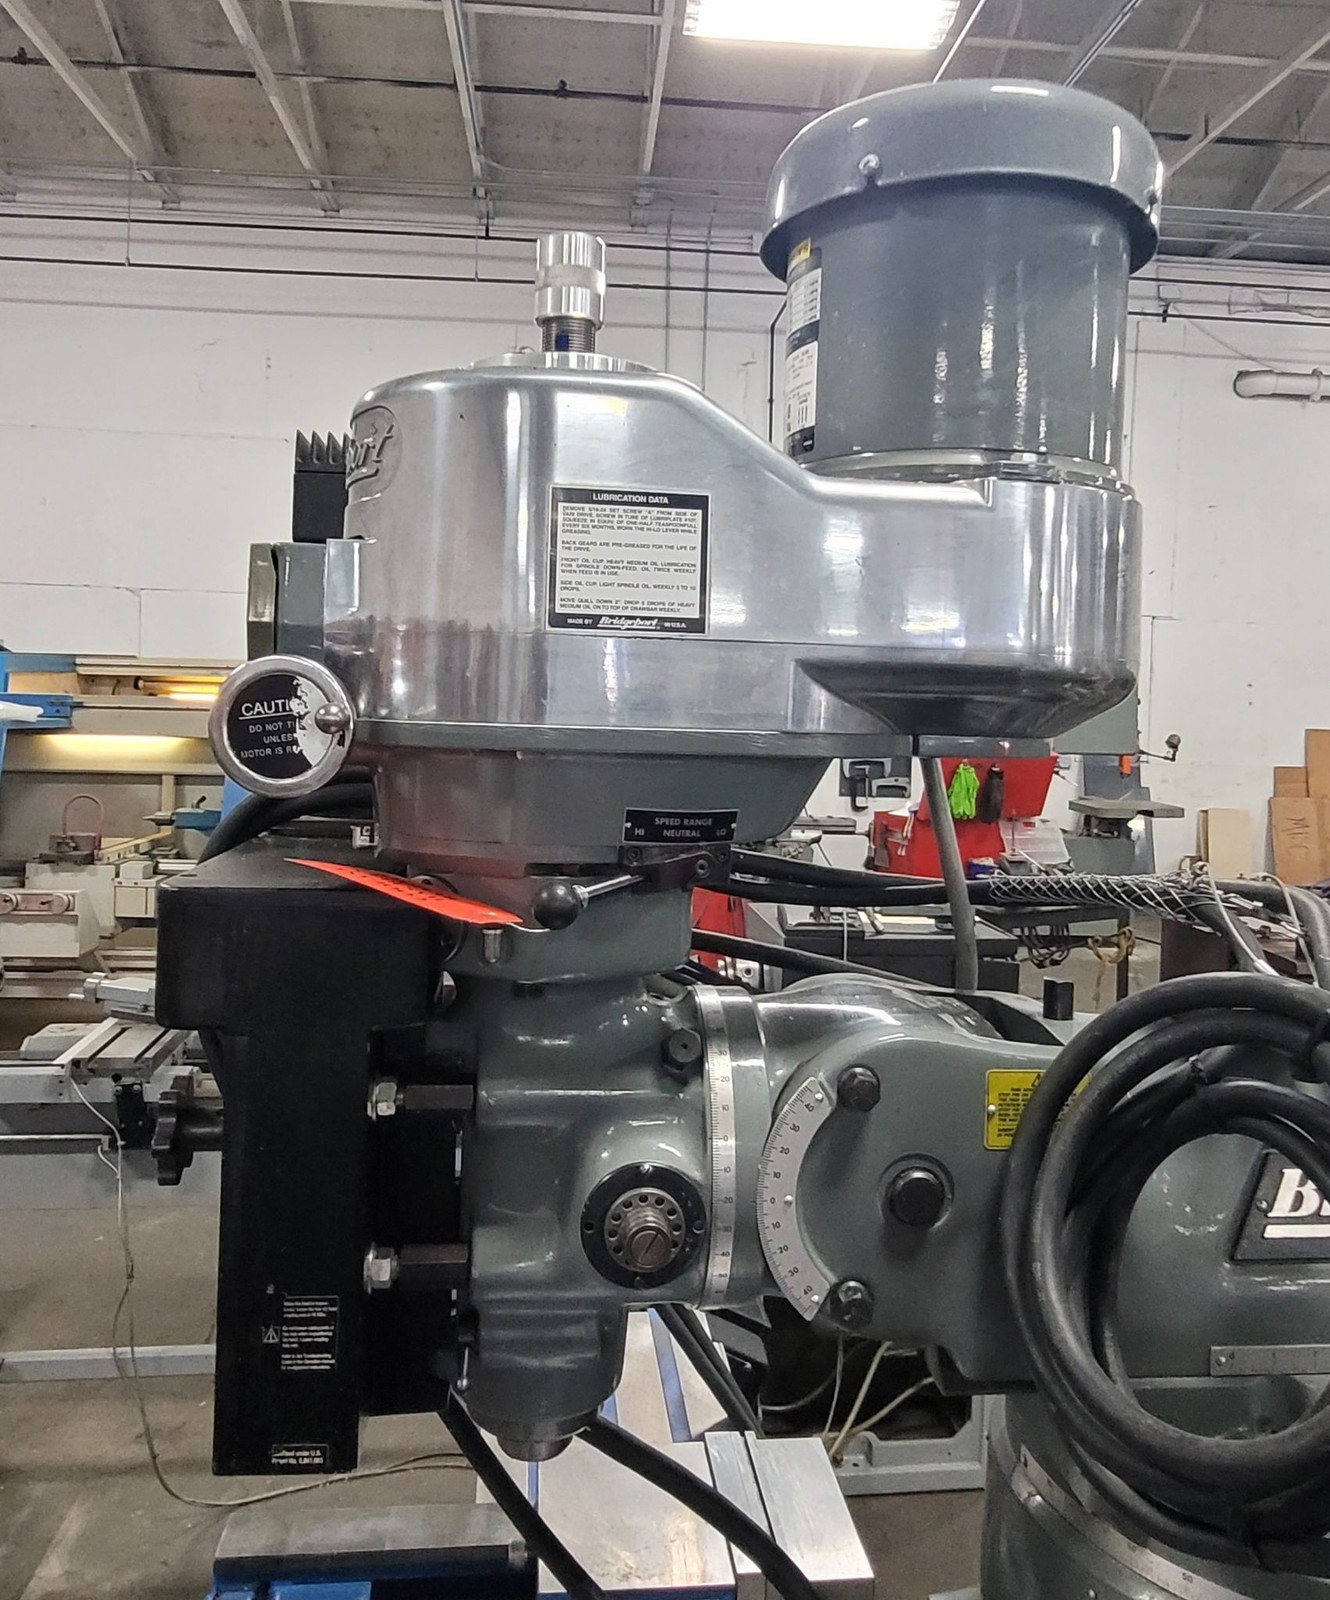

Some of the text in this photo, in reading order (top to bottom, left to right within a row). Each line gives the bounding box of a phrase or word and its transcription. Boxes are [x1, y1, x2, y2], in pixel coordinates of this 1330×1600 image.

[592, 492, 669, 504] LUBRICATION DATA
[598, 616, 658, 630] Bridgeport
[241, 699, 290, 716] CAUTI
[248, 724, 262, 734] DO
[265, 721, 283, 732] NOT
[274, 746, 284, 755] IS
[654, 817, 681, 826] SPEED
[634, 828, 645, 836] HI
[662, 829, 701, 837] NEUTRAL
[804, 1102, 815, 1112] 40
[790, 1124, 800, 1133] 30
[780, 1146, 790, 1155] 20
[773, 1171, 781, 1180] 10
[772, 1221, 781, 1230] 10
[778, 1244, 789, 1254] 20
[788, 1266, 799, 1277] 30
[802, 1285, 813, 1296] 40
